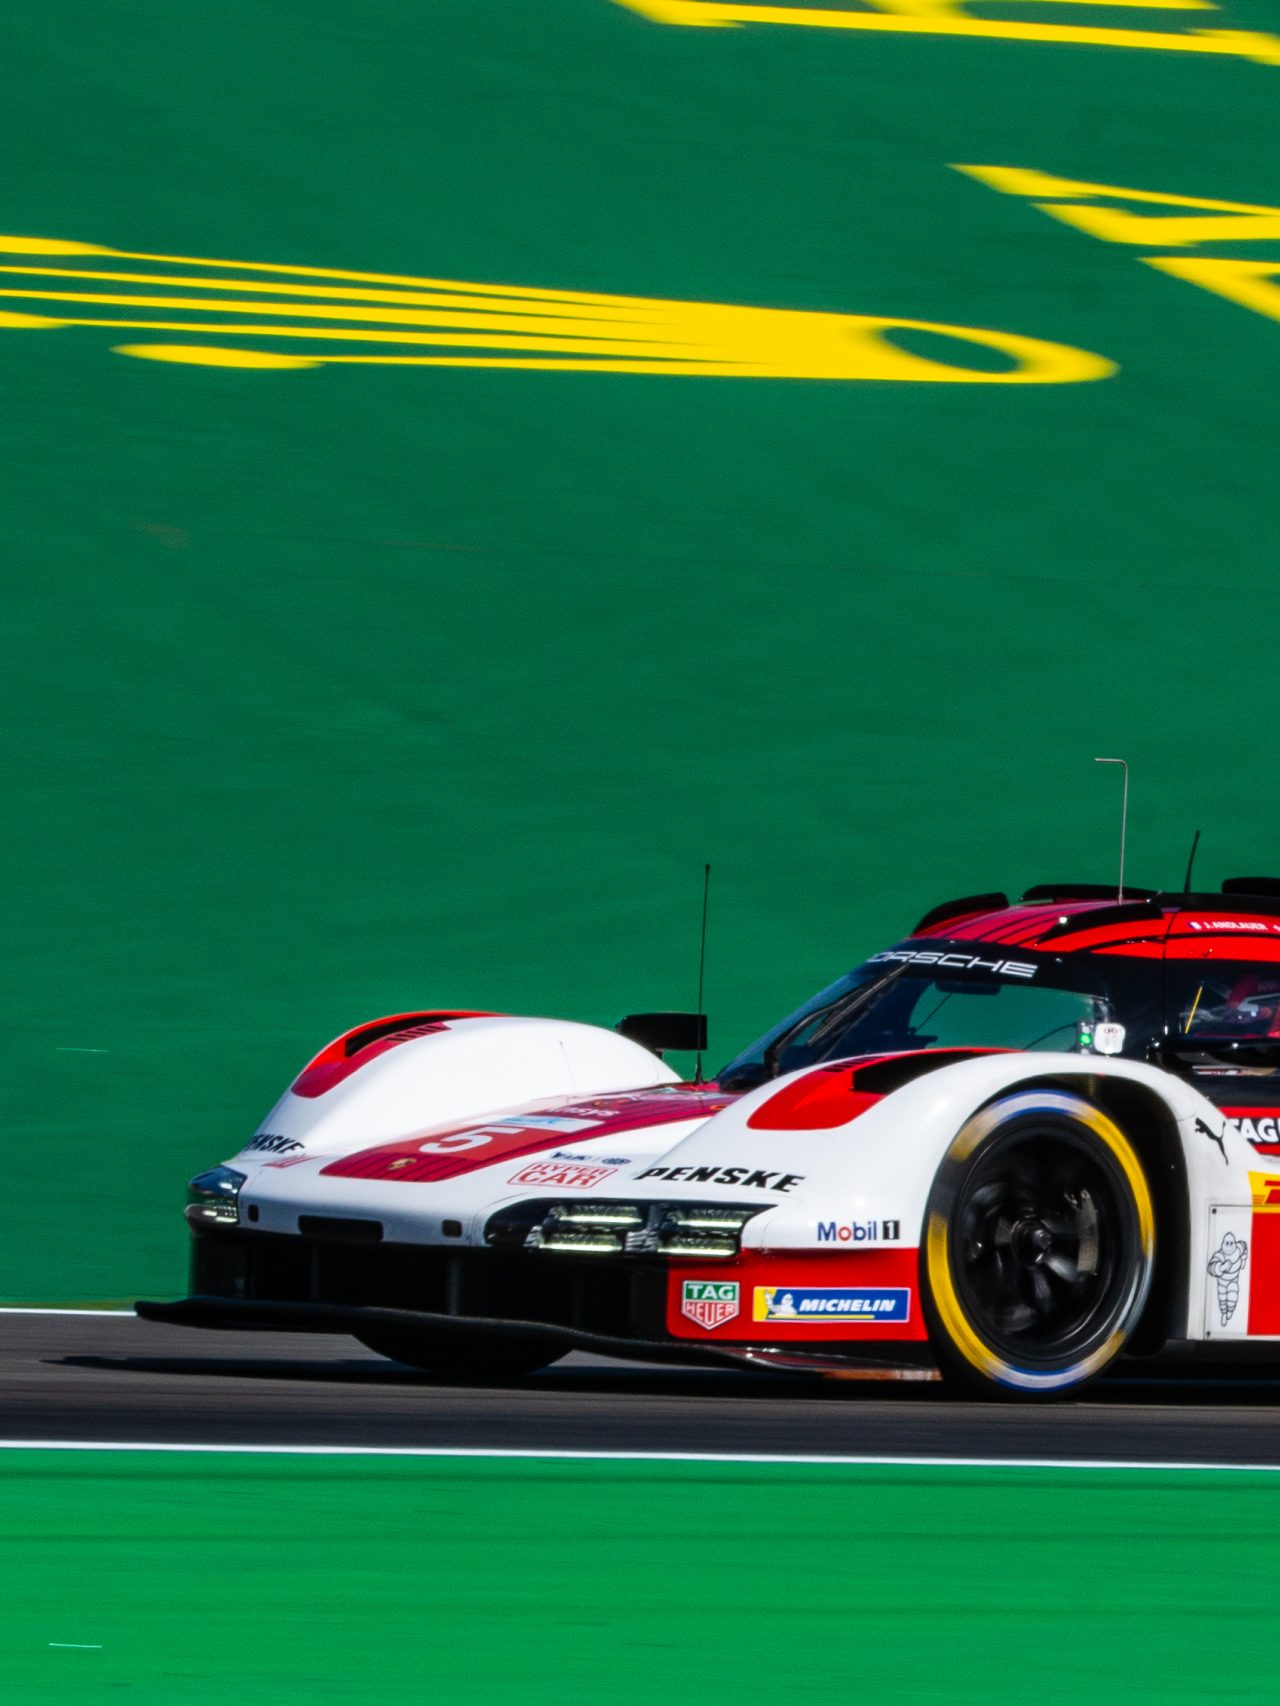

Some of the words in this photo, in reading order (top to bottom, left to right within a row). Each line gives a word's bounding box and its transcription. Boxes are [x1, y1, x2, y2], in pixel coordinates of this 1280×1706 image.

[866, 951, 1038, 978] ORSCHE
[419, 1126, 526, 1154] 5
[518, 1170, 596, 1186] CAR
[633, 1166, 805, 1193] PENSKE
[817, 1221, 877, 1242] Mobil
[884, 1221, 898, 1240] 1
[688, 1284, 734, 1300] TAG
[686, 1302, 736, 1324] HEUER
[799, 1298, 896, 1312] MICHELIN
